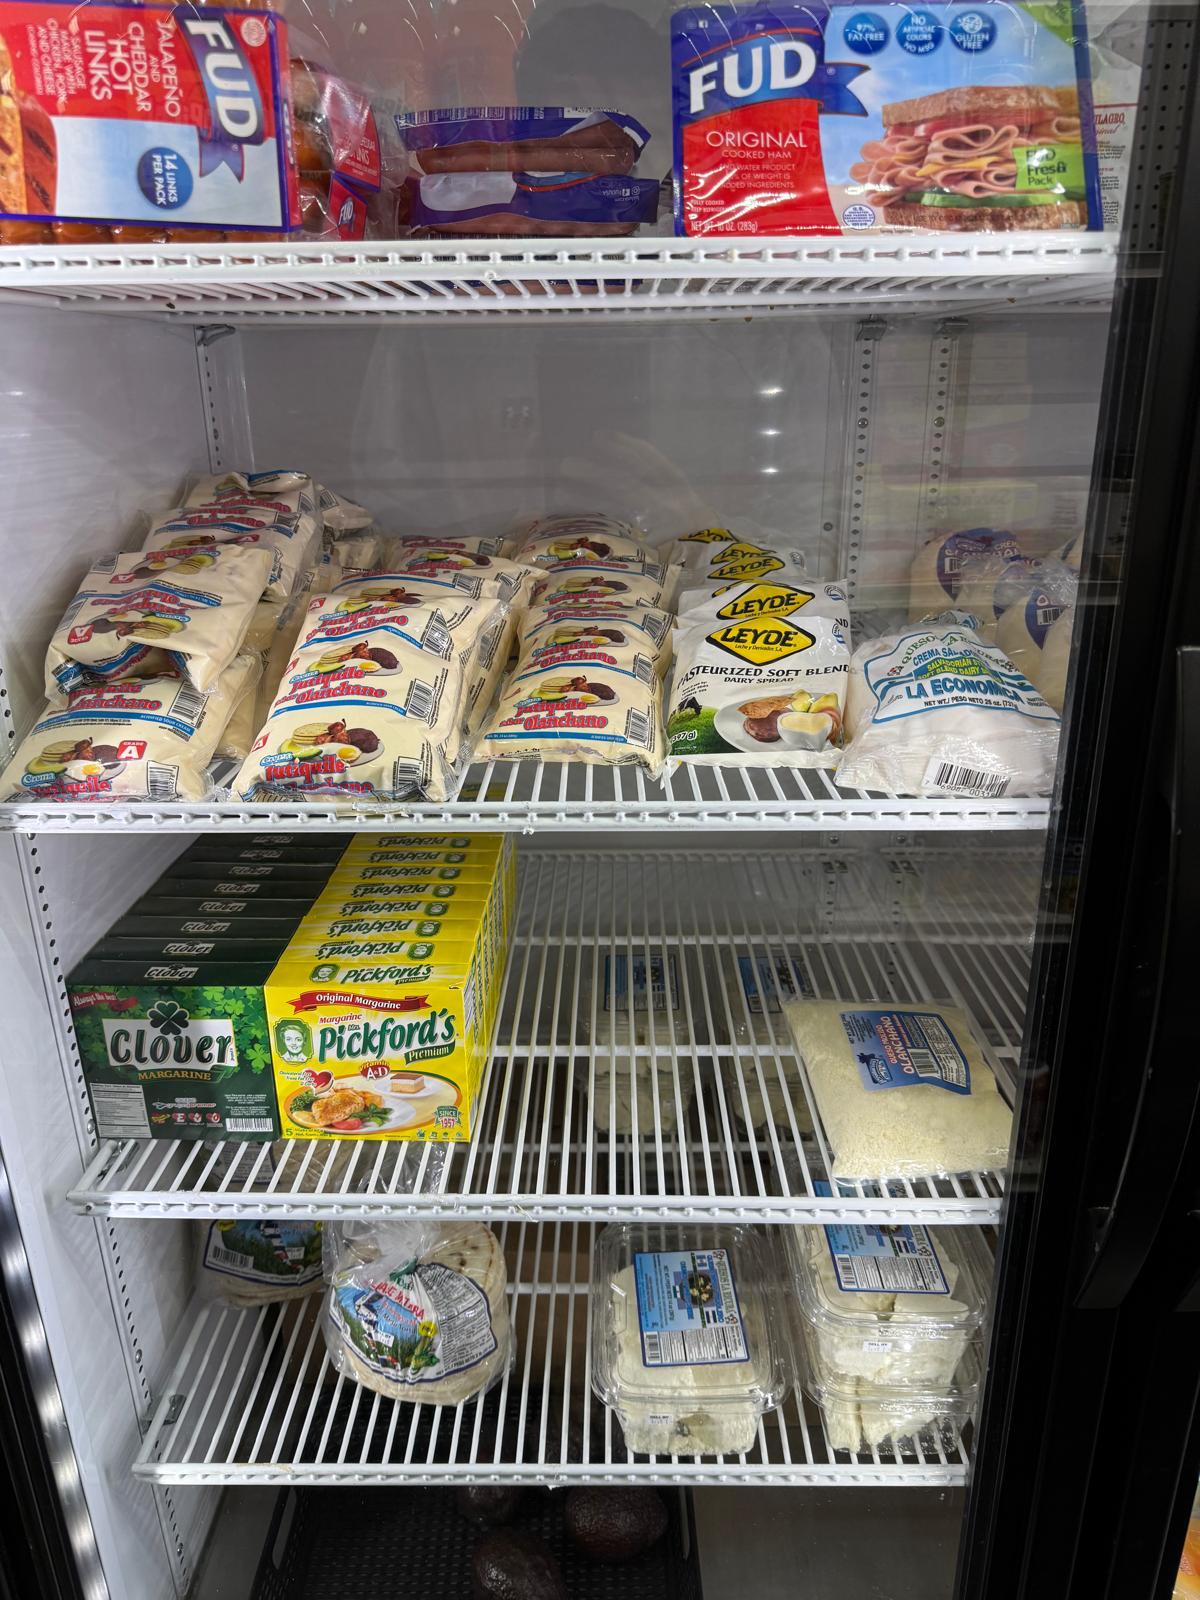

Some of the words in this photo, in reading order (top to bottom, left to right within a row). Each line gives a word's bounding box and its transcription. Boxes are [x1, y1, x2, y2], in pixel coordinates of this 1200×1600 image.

[856, 23, 876, 32] 97%
[911, 16, 926, 26] NO
[37, 26, 51, 52] AND
[848, 32, 863, 41] FAT
[864, 32, 885, 41] FREE
[955, 33, 989, 42] GLUTEN
[962, 41, 982, 49] FREE
[904, 43, 916, 53] NO
[71, 36, 86, 89] SAUSAGE
[83, 30, 112, 100] LINKS
[107, 39, 133, 95] HOT
[127, 21, 152, 112] CHEDDAR
[149, 55, 160, 83] AND
[156, 19, 182, 117] JALAPEÑO
[40, 54, 55, 96] CHEESE
[185, 18, 262, 139] FUD
[689, 40, 817, 114] FUD
[705, 131, 807, 148] ORIGINAL
[164, 154, 179, 170] 14
[721, 150, 765, 159] COOKED
[767, 150, 792, 159] HAM
[152, 154, 162, 175] PER
[166, 172, 178, 202] LINKS
[1028, 175, 1053, 186] Pack
[154, 177, 166, 205] PACK
[339, 197, 353, 226] FUD
[737, 221, 758, 232] (283g)
[719, 558, 775, 577] LEYDE
[730, 592, 799, 617] LEYDE
[720, 627, 796, 648] LEYDE
[913, 649, 940, 667] CREMA
[677, 665, 763, 690] PASTEURIZED
[766, 669, 802, 677] SOFT
[805, 664, 850, 676] BLEND
[959, 666, 979, 675] DAIRY
[724, 676, 754, 684] DAIRY
[905, 682, 929, 699] LA
[930, 677, 1025, 704] ECONOMICA
[924, 699, 936, 707] NET
[968, 697, 984, 705] NETO
[120, 746, 139, 758] A
[262, 753, 292, 764] Crema
[22, 773, 55, 785] Crema
[350, 884, 429, 898] Pickford's
[199, 902, 244, 911] Clover
[338, 901, 420, 916] Pickford's
[182, 922, 229, 932] Clover
[326, 920, 412, 938] Pickford's
[164, 944, 212, 953] Clover
[315, 941, 404, 958] Pickford's
[146, 968, 196, 978] Clover
[340, 964, 434, 984] Pickford's
[316, 993, 354, 1005] Original
[354, 997, 401, 1010] Margarine
[318, 1013, 363, 1024] Margarine
[318, 1008, 457, 1063] Pickford's
[110, 1027, 233, 1064] Clover
[408, 1045, 451, 1061] Premium
[880, 1015, 915, 1075] OLANCHANO
[137, 1070, 212, 1081] MARGARINE
[366, 1066, 389, 1080] A&D
[286, 1128, 293, 1136] 5
